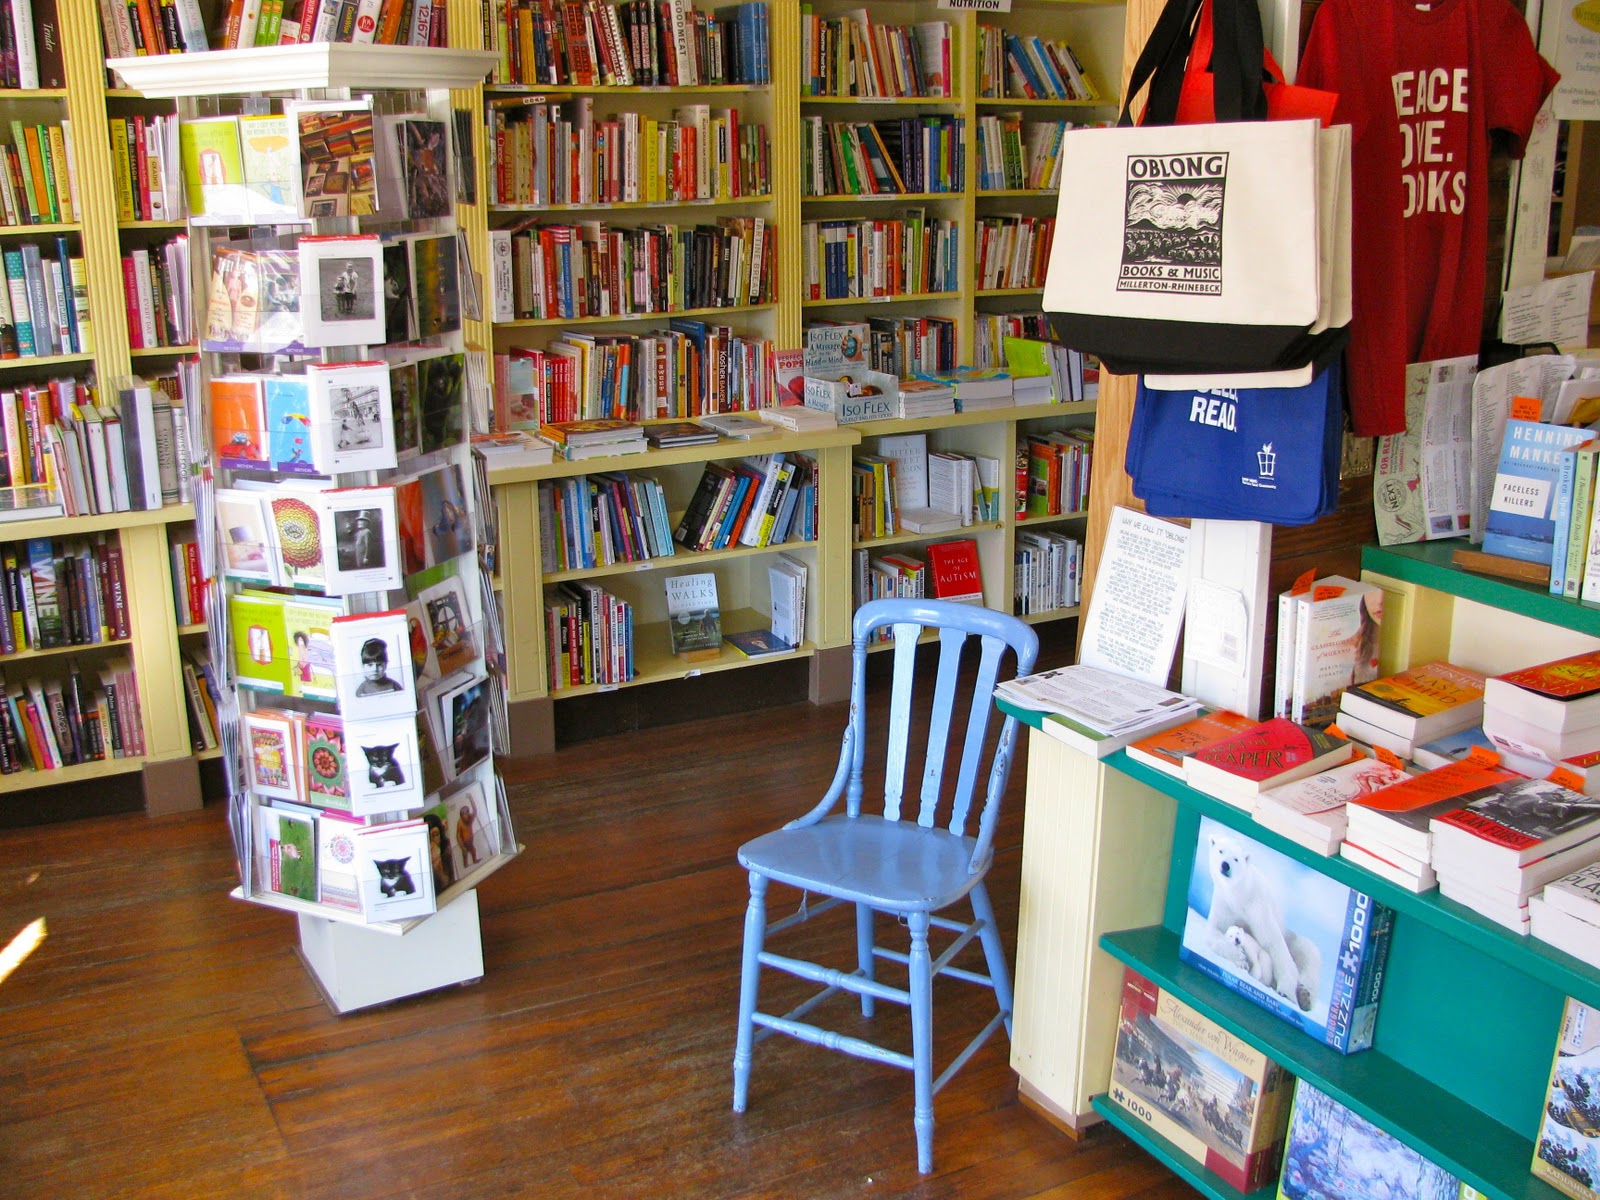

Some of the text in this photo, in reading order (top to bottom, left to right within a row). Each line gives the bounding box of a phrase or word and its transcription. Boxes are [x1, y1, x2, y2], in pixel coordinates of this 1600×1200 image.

[950, 0, 999, 10] NUTRITION
[417, 5, 430, 39] 12,167
[600, 5, 615, 48] EVERYBODY
[43, 23, 56, 53] Tender
[497, 137, 505, 165] Cheese
[1131, 156, 1223, 178] OBLONG
[122, 191, 130, 207] Bible
[750, 218, 764, 297] TARTINE BREAD
[1123, 266, 1220, 279] BOOKS & MUSIC
[1119, 281, 1220, 293] MILLERTON-RHINEBECK
[35, 279, 47, 328] FRENCH COOKING
[816, 343, 841, 351] Massage
[825, 331, 843, 341] FLEX
[778, 360, 804, 369] POPS
[805, 356, 844, 367] Hand Mind
[864, 402, 890, 414] FLEX
[1189, 396, 1237, 433] READ.
[1513, 426, 1584, 447] HENNING
[176, 425, 188, 483] JEWISH FOOD
[1379, 453, 1389, 475] FOR
[1509, 445, 1561, 465] MANKE
[773, 489, 783, 508] Massage
[1386, 483, 1399, 509] NEXT
[1503, 483, 1540, 496] FACELESS
[1559, 465, 1571, 517] Broken Open
[1503, 496, 1534, 508] KILLERS
[1122, 517, 1132, 526] WHY
[1133, 521, 1141, 529] WE
[1142, 524, 1155, 534] CALL
[1156, 528, 1164, 536] IT
[1574, 519, 1582, 542] Death
[33, 557, 60, 618] WINE
[671, 578, 713, 588] Healing
[940, 571, 977, 584] AUTISM
[114, 582, 123, 609] WINE
[672, 589, 714, 601] WALKS
[1415, 674, 1466, 695] LAST
[54, 701, 67, 733] Erotica
[1203, 749, 1284, 769] REAPER
[1302, 782, 1344, 803] FULLNESS
[1313, 794, 1337, 806] TIME
[1451, 811, 1534, 846] ALAN FURST
[1349, 891, 1369, 950] 1000
[1371, 971, 1383, 1003] 1000
[1326, 970, 1346, 1044] EUROGRAPHICS
[1333, 975, 1355, 1050] PUZZLE
[1160, 998, 1207, 1035] Alexander
[1207, 1030, 1221, 1045] von
[1218, 1031, 1256, 1067] Wagner
[1127, 1098, 1152, 1122] 1000
